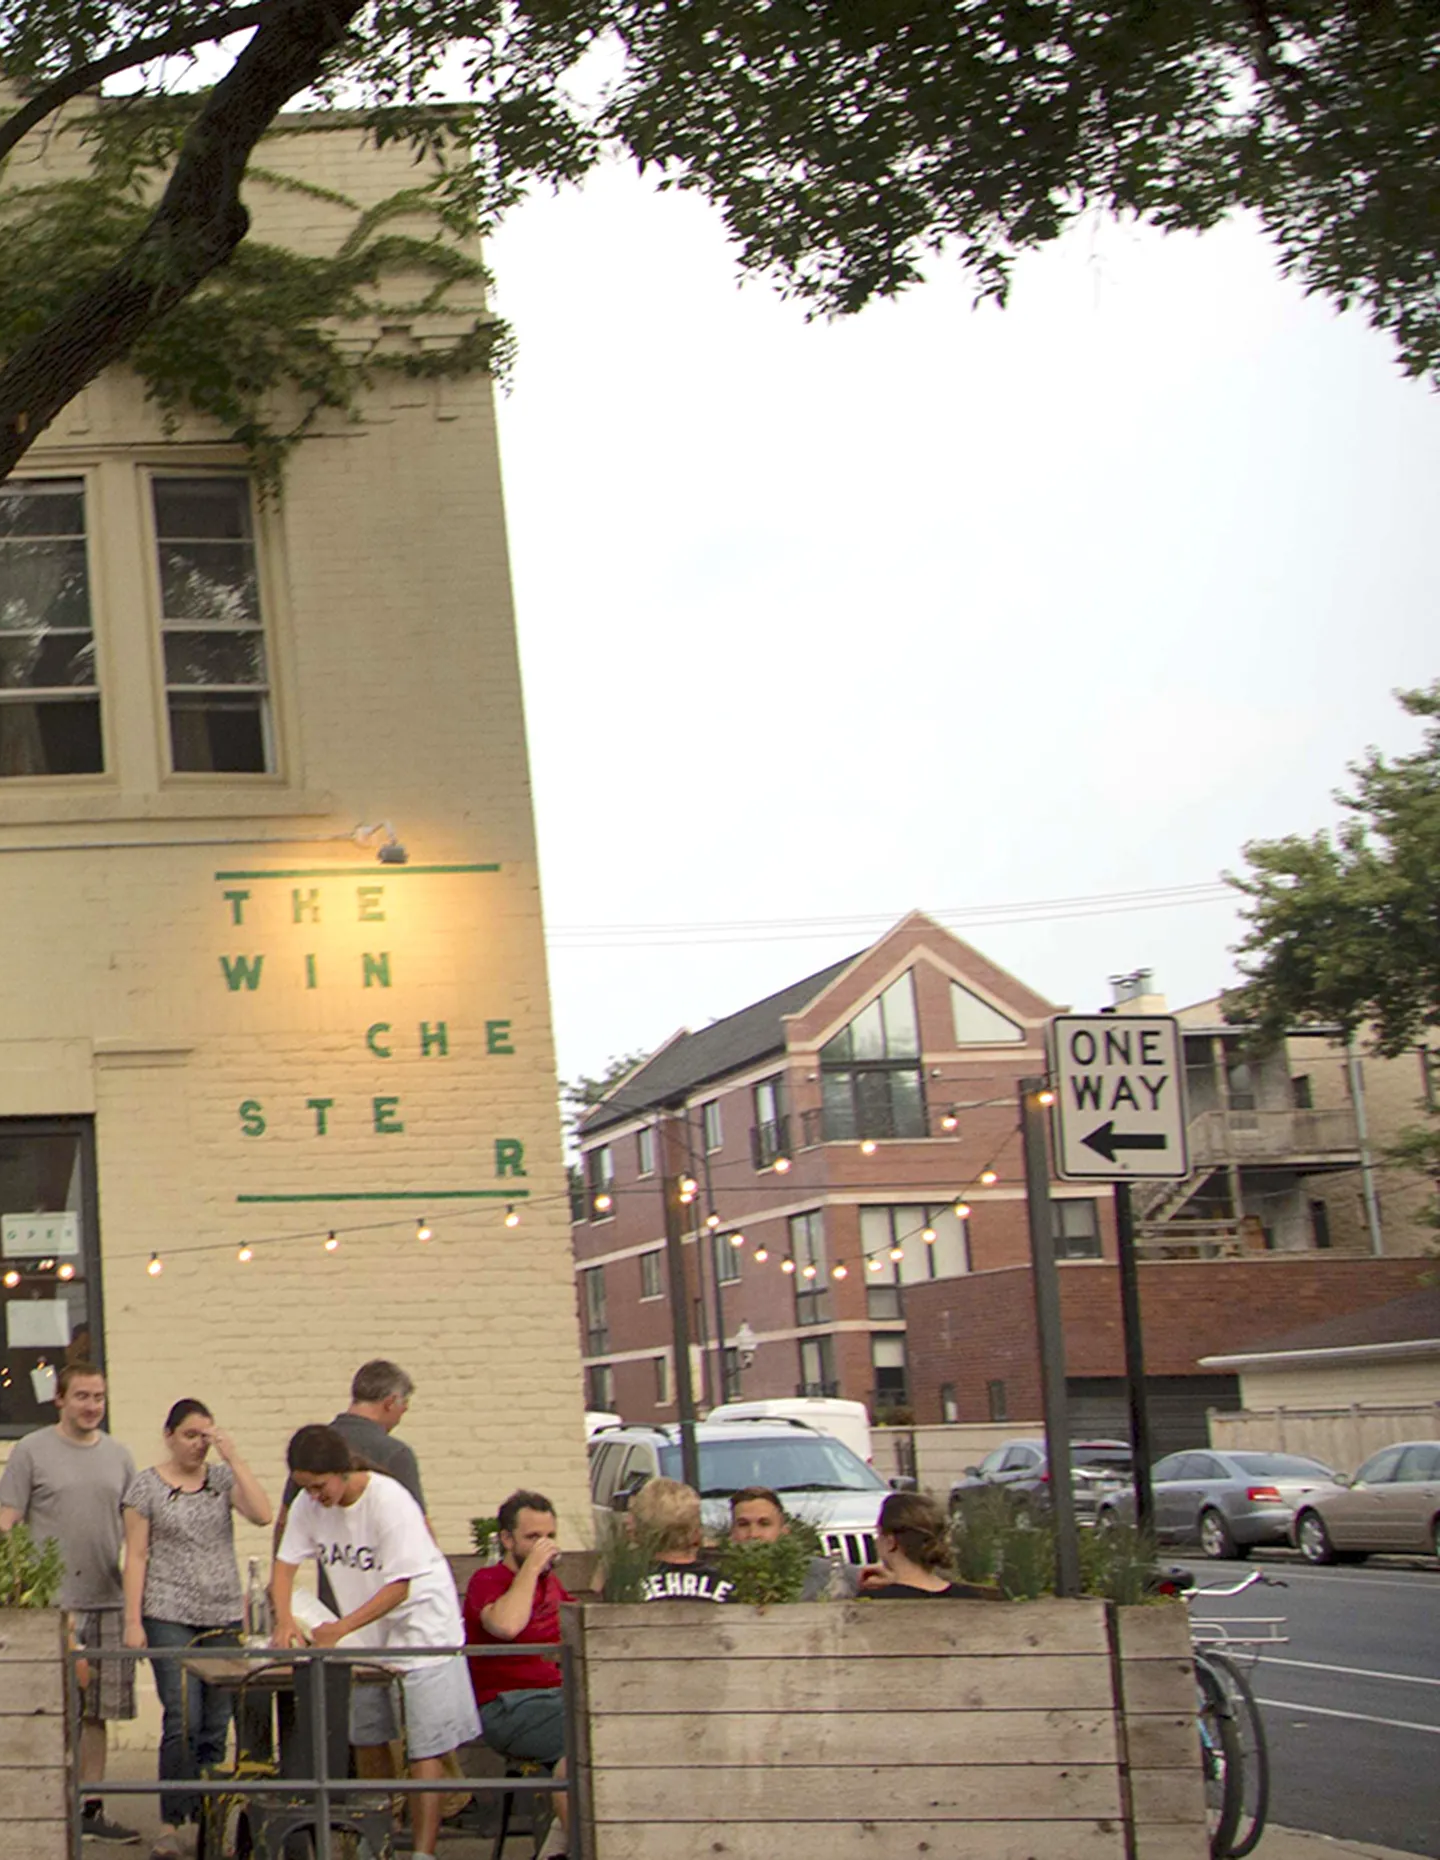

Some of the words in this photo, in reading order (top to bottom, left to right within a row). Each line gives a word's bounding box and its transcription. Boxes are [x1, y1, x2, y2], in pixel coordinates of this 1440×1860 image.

[223, 886, 385, 925] THE
[219, 952, 392, 991] WIN
[367, 1019, 516, 1059] CHE
[1071, 1029, 1166, 1066] ONE
[1071, 1075, 1169, 1112] WAY
[239, 1096, 405, 1137] STE
[495, 1138, 527, 1177] R
[6, 1228, 73, 1241] OPEN
